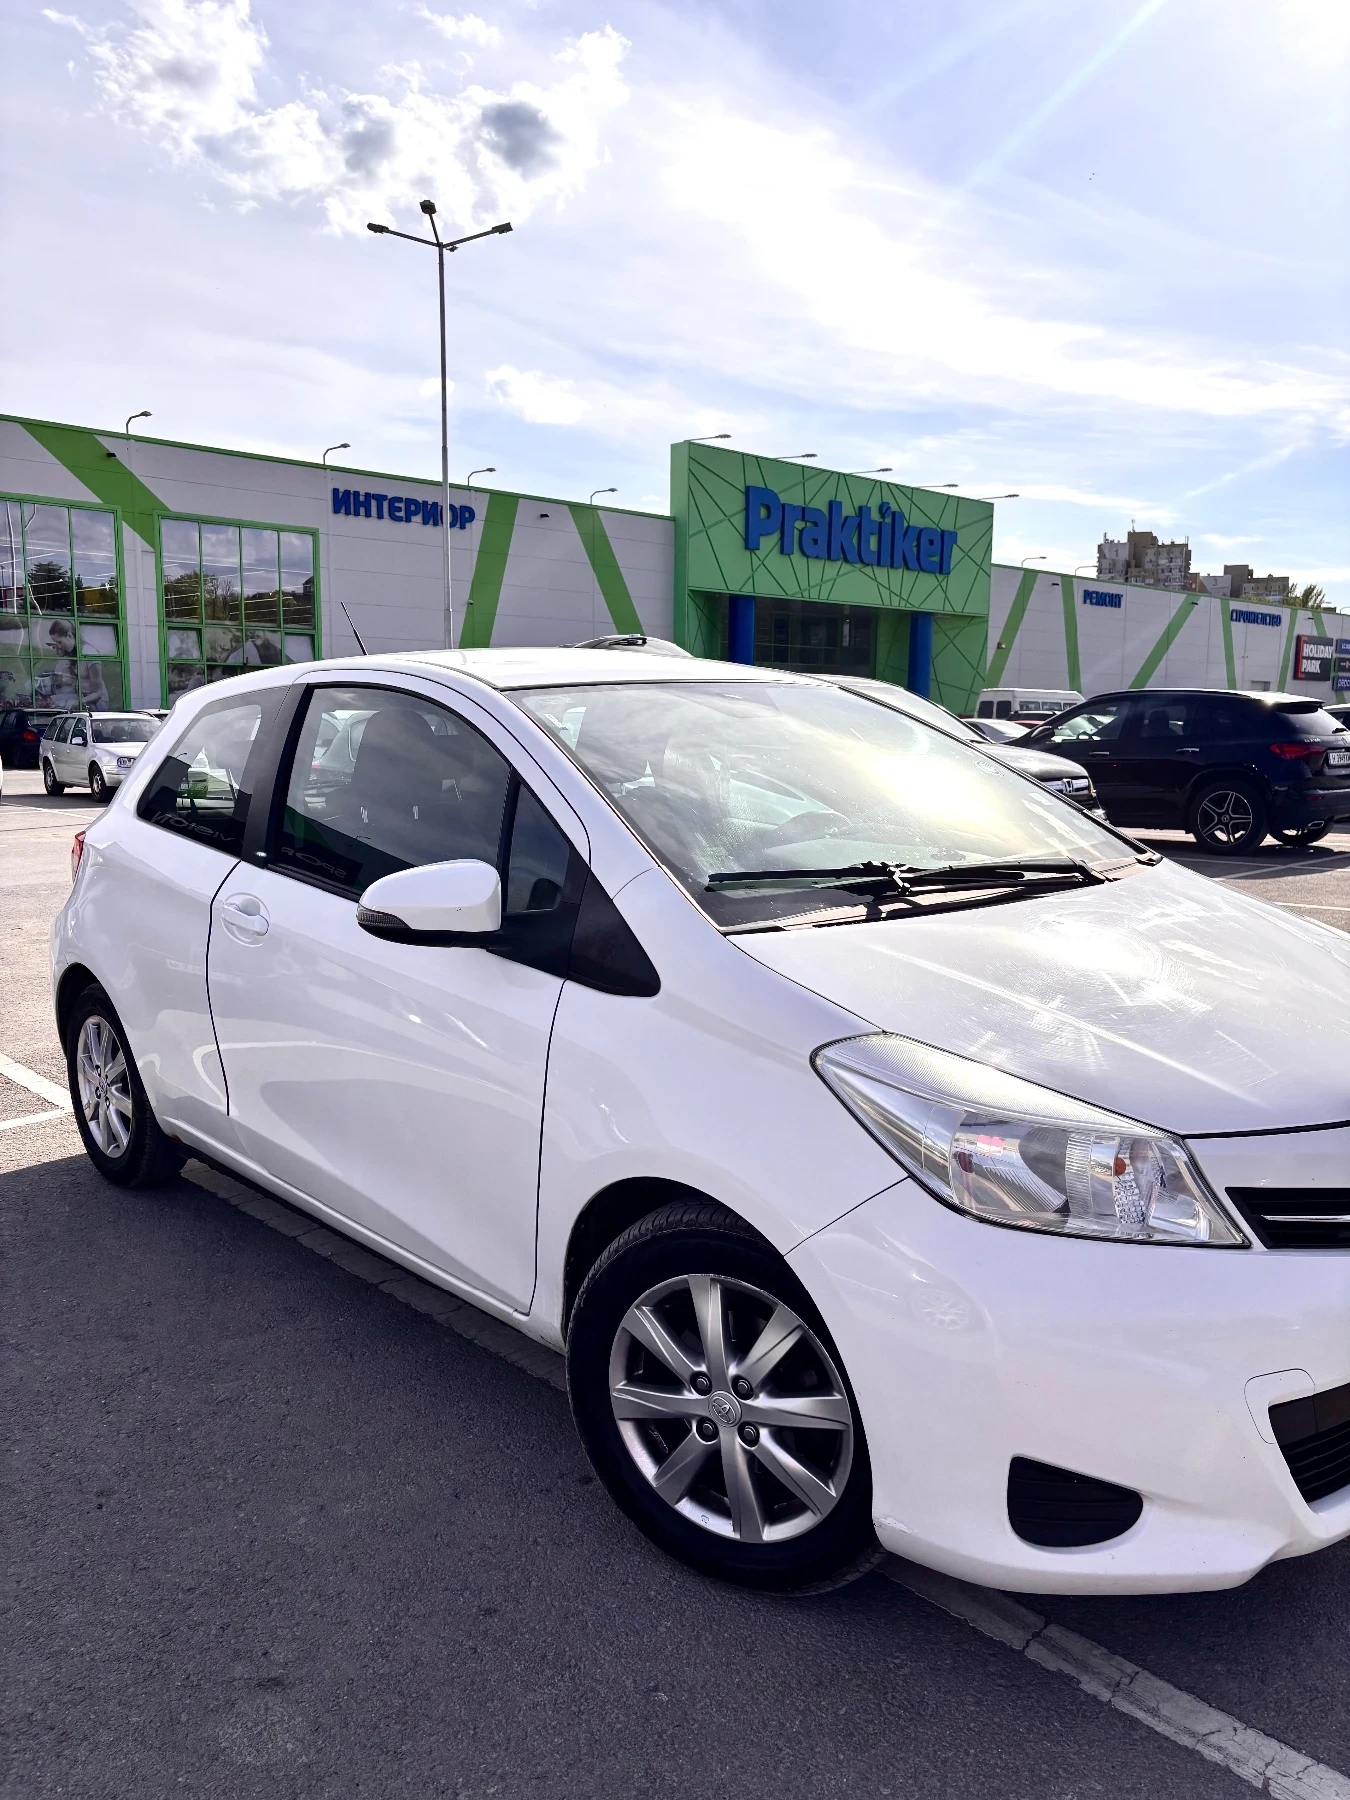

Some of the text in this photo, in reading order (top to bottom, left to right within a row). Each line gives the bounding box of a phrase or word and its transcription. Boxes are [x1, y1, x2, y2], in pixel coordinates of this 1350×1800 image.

[332, 487, 476, 529] ИНТЕРИОР
[745, 485, 957, 575] Praktiker
[1083, 589, 1123, 608] РЕМОНТ
[1303, 643, 1334, 658] HOLIDAY
[1301, 659, 1321, 673] PARK
